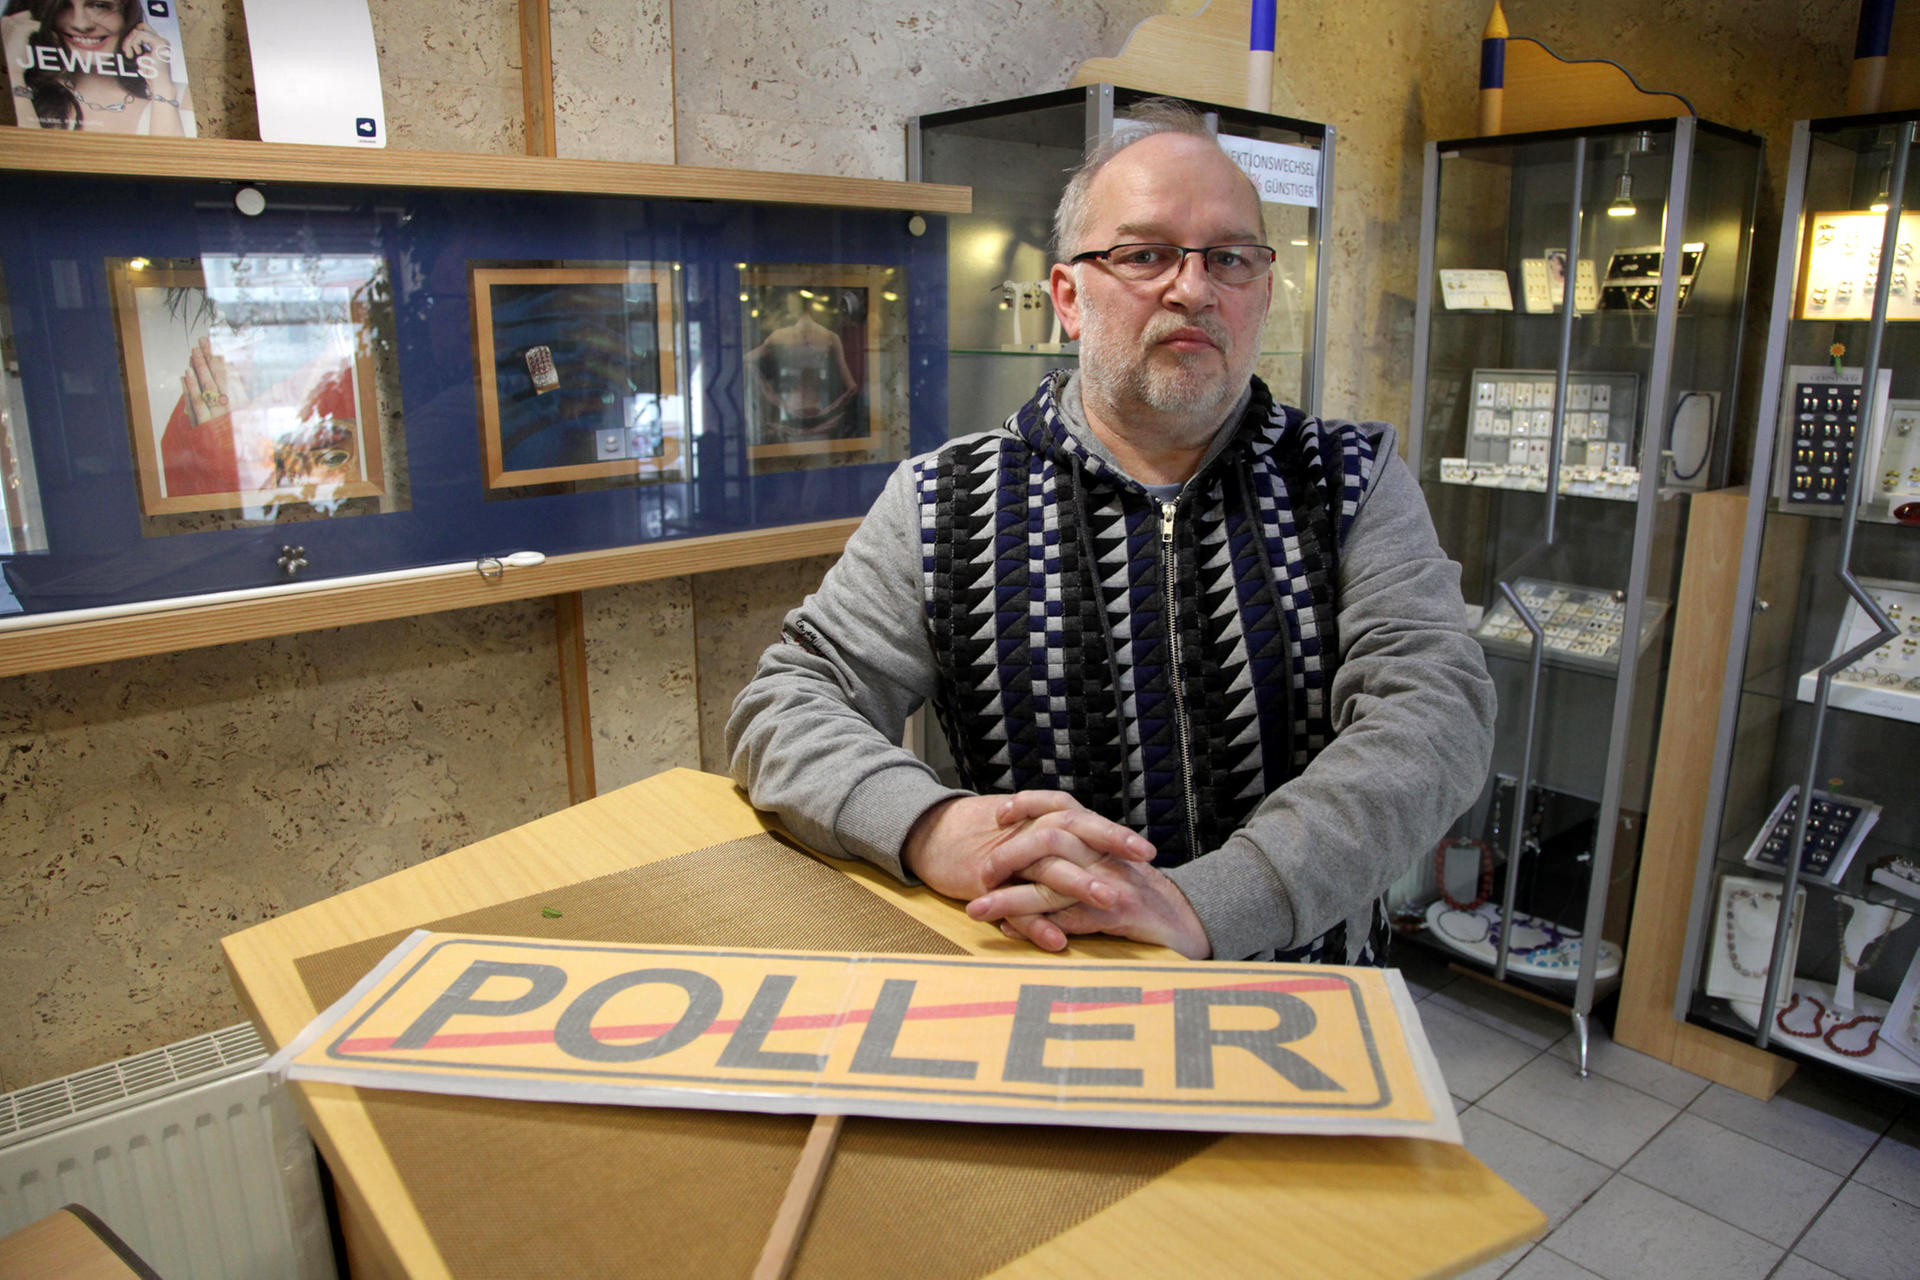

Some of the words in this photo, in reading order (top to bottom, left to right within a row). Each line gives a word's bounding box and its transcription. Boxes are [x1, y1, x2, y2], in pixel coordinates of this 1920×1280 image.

[16, 45, 158, 79] JEWELS
[1228, 150, 1315, 177] EKTIONSWECHSEL
[1264, 179, 1314, 199] GÜNSTIGER
[390, 959, 1347, 1093] POLLER
